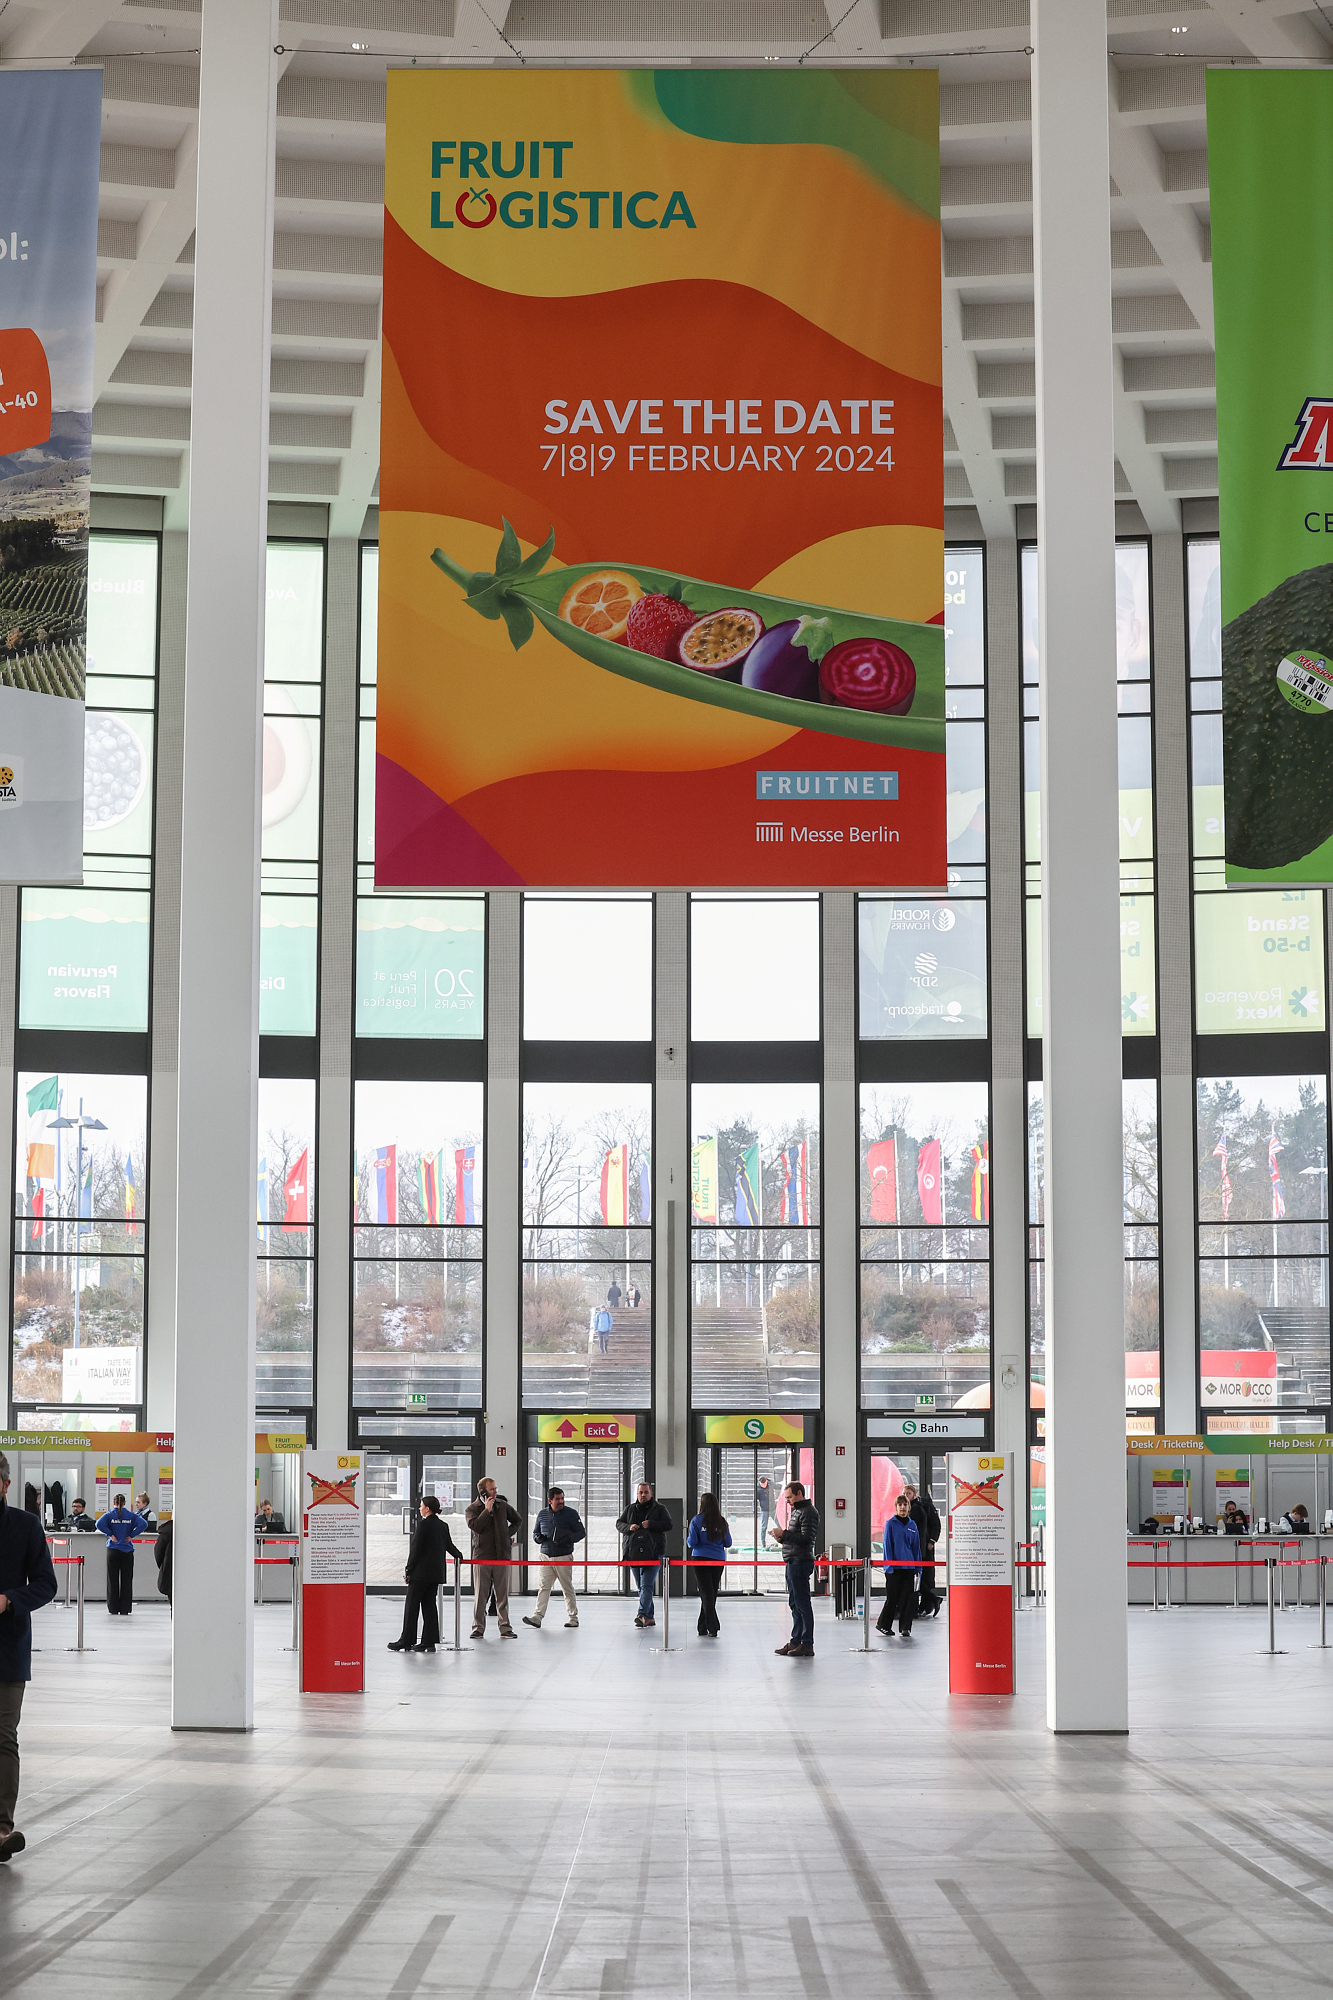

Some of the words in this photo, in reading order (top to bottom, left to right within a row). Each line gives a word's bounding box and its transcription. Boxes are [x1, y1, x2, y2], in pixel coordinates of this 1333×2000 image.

[431, 141, 574, 179] FRUIT
[430, 188, 697, 229] LOGISTICA
[543, 399, 664, 435] SAVE
[673, 399, 762, 435] THE
[773, 399, 895, 435] DATE
[539, 443, 616, 477] 7|8|9
[628, 445, 806, 472] FEBRUARY
[814, 445, 896, 472] 2024
[1290, 690, 1312, 707] 4770
[761, 776, 894, 795] FRUITNET
[790, 826, 844, 842] Messe
[849, 825, 900, 842] Berlin
[87, 1367, 115, 1379] ITALIAN
[115, 1367, 132, 1378] WAY
[1219, 1381, 1273, 1397] MOROCCO
[587, 1427, 605, 1436] Exit
[607, 1423, 616, 1436] C
[747, 1420, 761, 1438] S
[920, 1423, 949, 1433] Bahn
[18, 1435, 42, 1445] Desk
[49, 1436, 91, 1447] Ticketing
[1131, 1440, 1154, 1449] Desk
[1162, 1440, 1204, 1449] Ticketing
[1268, 1439, 1290, 1449] Help
[1293, 1439, 1315, 1448] Desk
